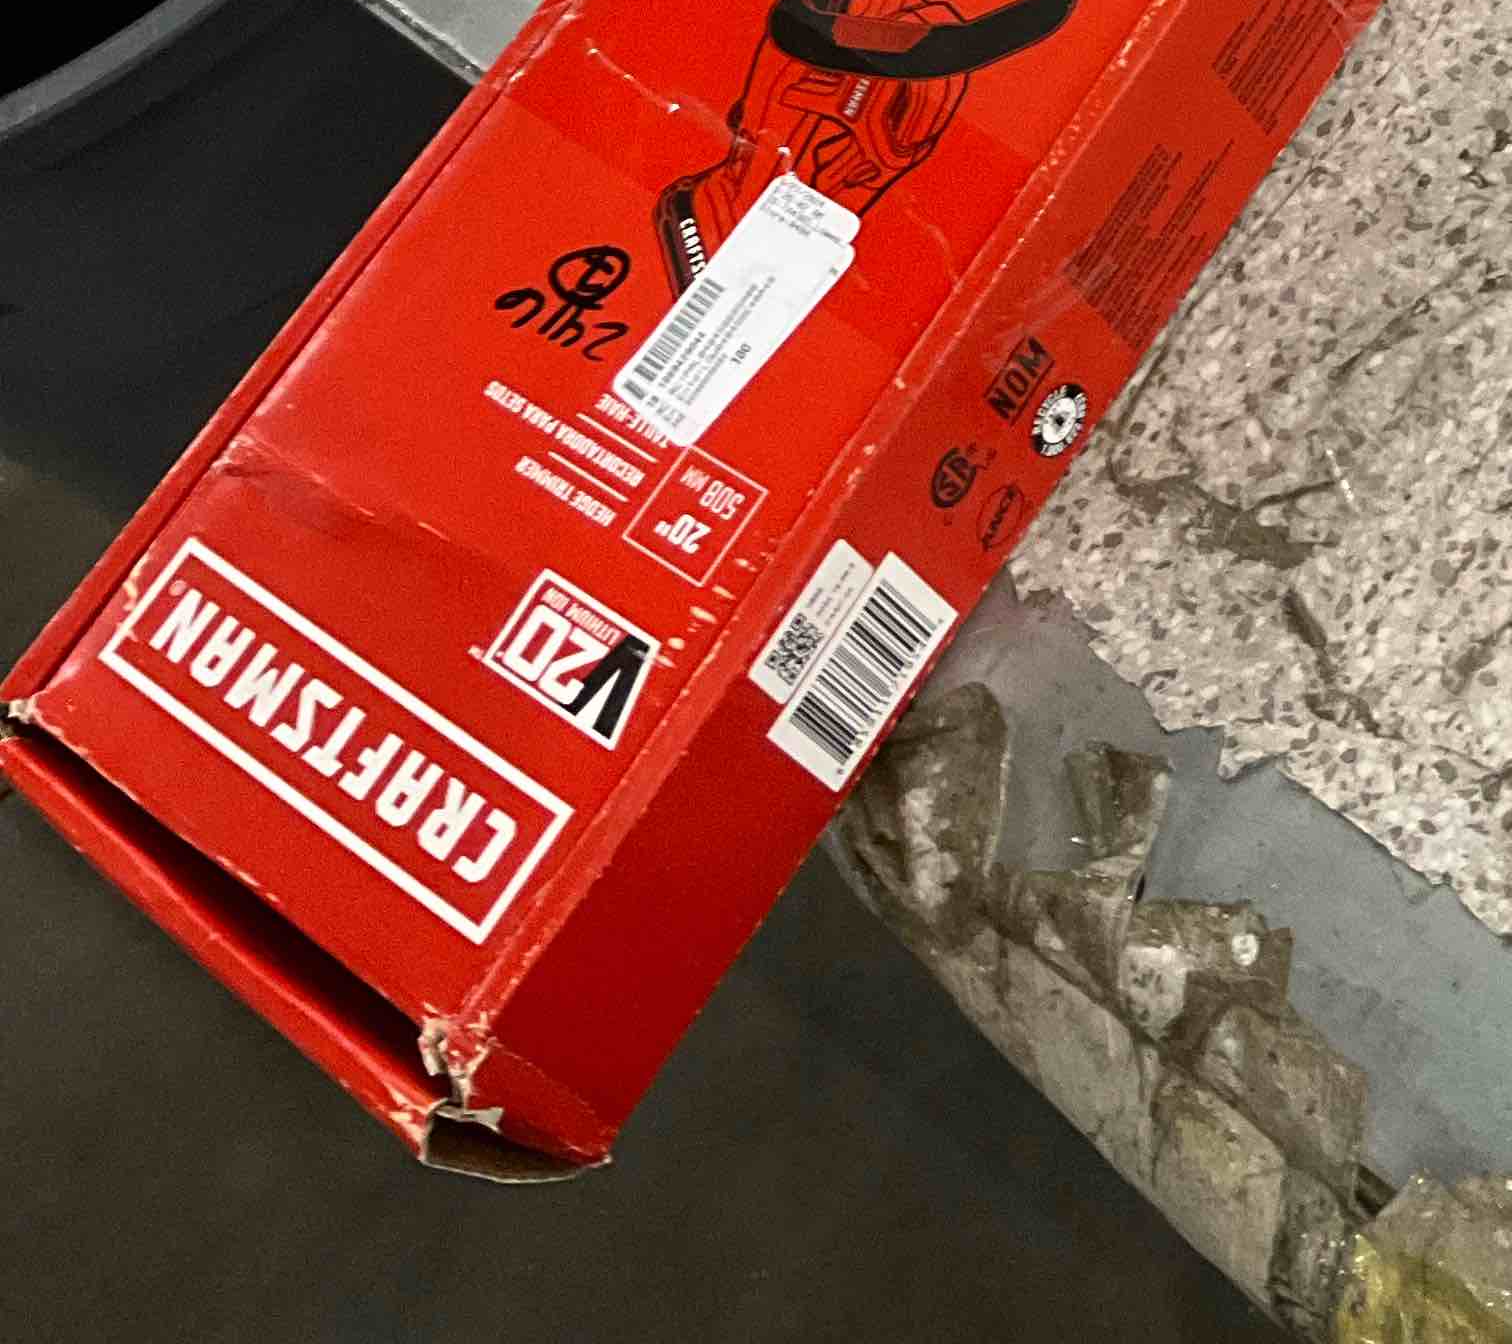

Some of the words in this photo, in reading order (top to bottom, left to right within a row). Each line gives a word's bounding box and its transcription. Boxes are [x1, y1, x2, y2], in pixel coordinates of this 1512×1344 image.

[481, 378, 527, 415] SETOS
[982, 335, 1056, 421] NOM
[518, 400, 562, 436] PARA
[552, 420, 647, 487] RECORTADORA
[512, 453, 577, 502] TRIMMER
[677, 464, 710, 493] MM
[695, 476, 748, 522] 508
[568, 487, 618, 527] HEDGE
[651, 504, 713, 555] 20"
[539, 584, 571, 612] ION
[563, 601, 622, 643] LITHIUM
[495, 604, 646, 737] V20
[144, 583, 522, 887] CRAFTSMAN
